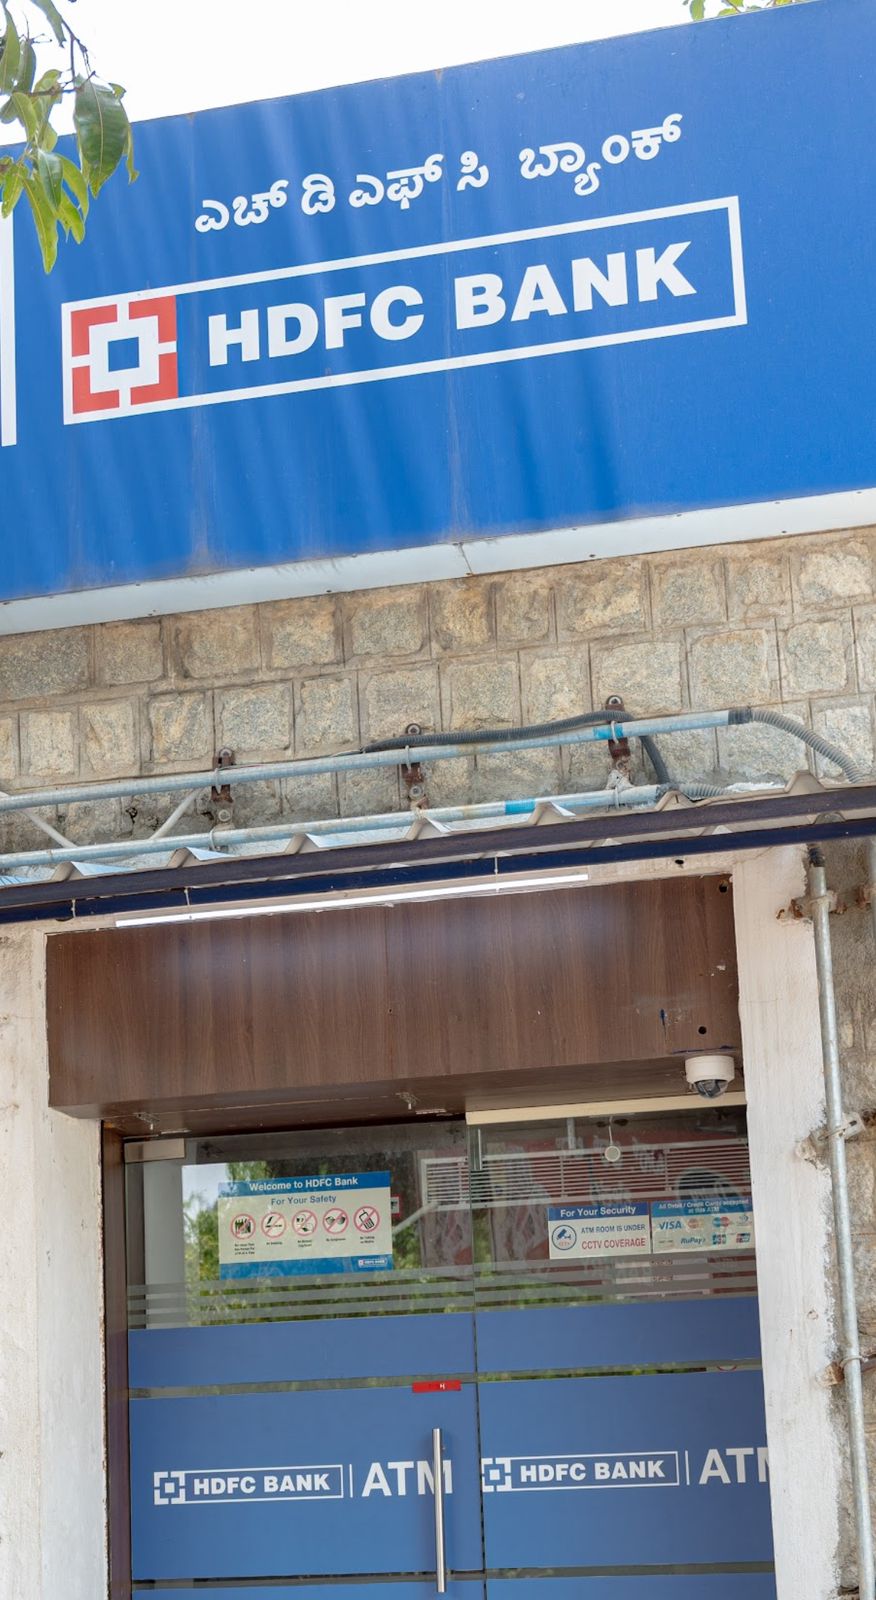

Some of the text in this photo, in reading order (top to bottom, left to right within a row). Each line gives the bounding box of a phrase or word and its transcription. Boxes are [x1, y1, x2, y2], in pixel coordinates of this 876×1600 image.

[195, 113, 683, 232] ಎಚ್ ಡಿ ಎಫ್ ಸಿ ಬ್ಯಾಂಕ್
[208, 241, 697, 366] HDFC BANK
[250, 1177, 358, 1192] Welcome to HDFC Bank
[271, 1195, 336, 1206] For Your Safety
[560, 1206, 636, 1218] For Your Security
[596, 1225, 615, 1233] ROOM
[623, 1224, 645, 1232] UNDER
[659, 1220, 682, 1230] VISA
[582, 1238, 646, 1250] CCTV COVERAGE
[194, 1459, 453, 1497] HDFC BANK ATM
[520, 1463, 586, 1483] HDFC
[594, 1460, 665, 1480] BANK
